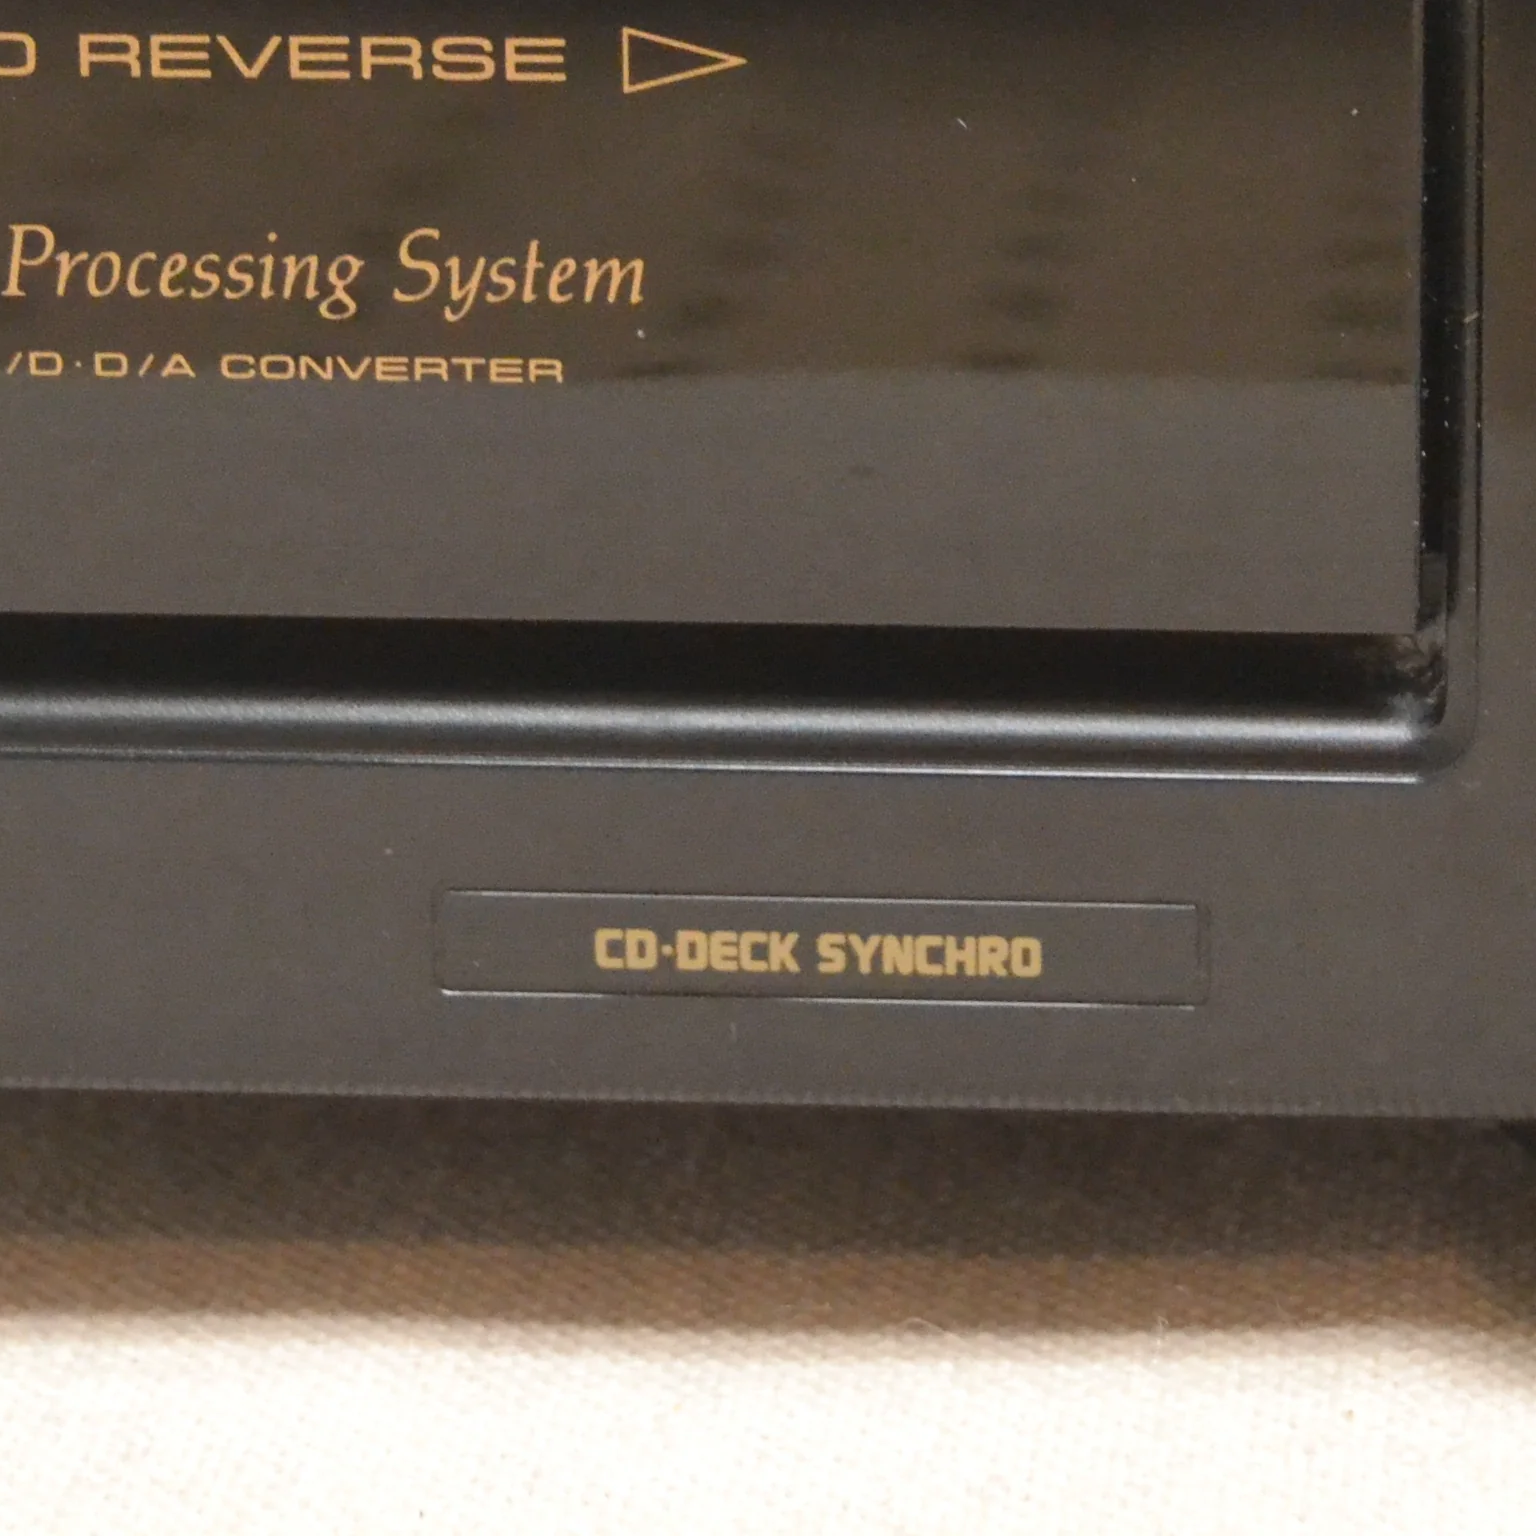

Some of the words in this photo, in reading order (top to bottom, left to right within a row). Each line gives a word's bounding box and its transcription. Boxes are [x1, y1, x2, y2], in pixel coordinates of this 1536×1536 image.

[78, 33, 567, 83] REVERSE
[2, 224, 365, 320] Processing
[392, 227, 645, 323] System
[220, 353, 564, 384] CONVERTER
[816, 932, 1042, 978] SYNCHRO
